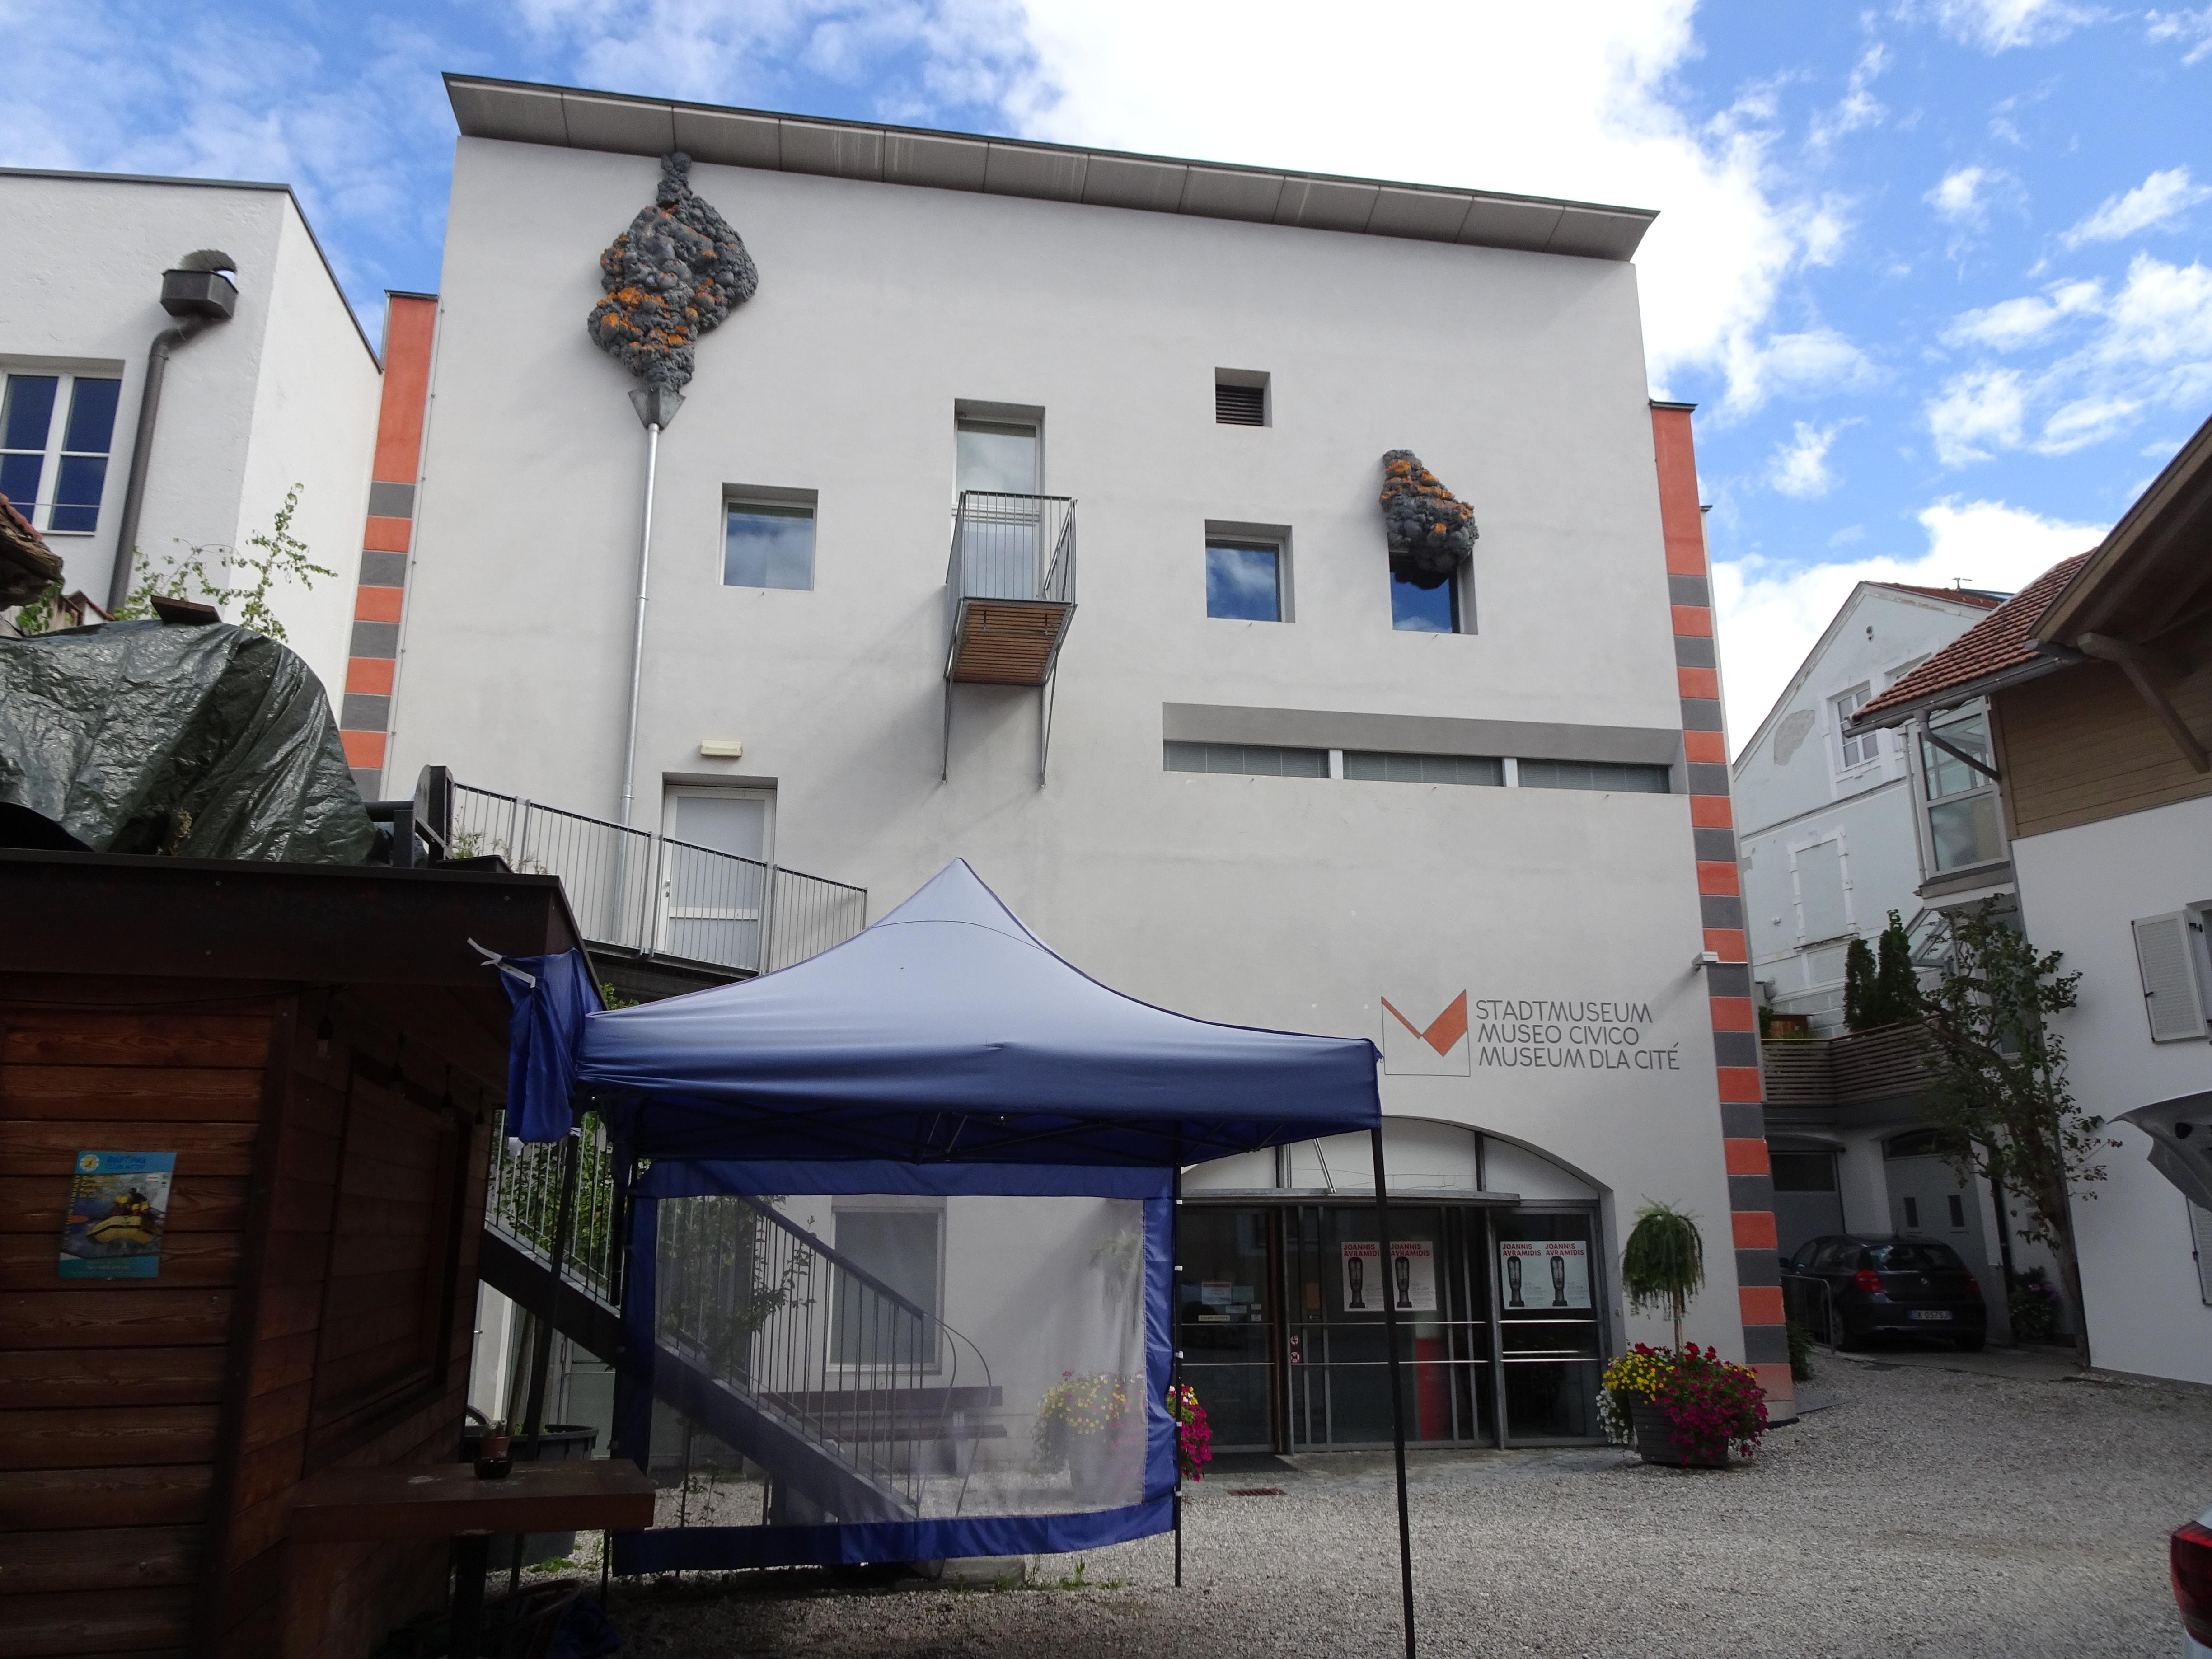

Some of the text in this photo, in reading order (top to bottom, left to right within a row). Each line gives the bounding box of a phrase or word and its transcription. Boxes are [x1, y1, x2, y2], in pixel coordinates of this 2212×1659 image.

[1476, 1000, 1653, 1023] STADTMUSEUM
[1477, 1024, 1639, 1045] MUSEO CIVICO
[1479, 1041, 1680, 1070] MUSEUM DLA CITÉ
[70, 1174, 80, 1207] COMPANY
